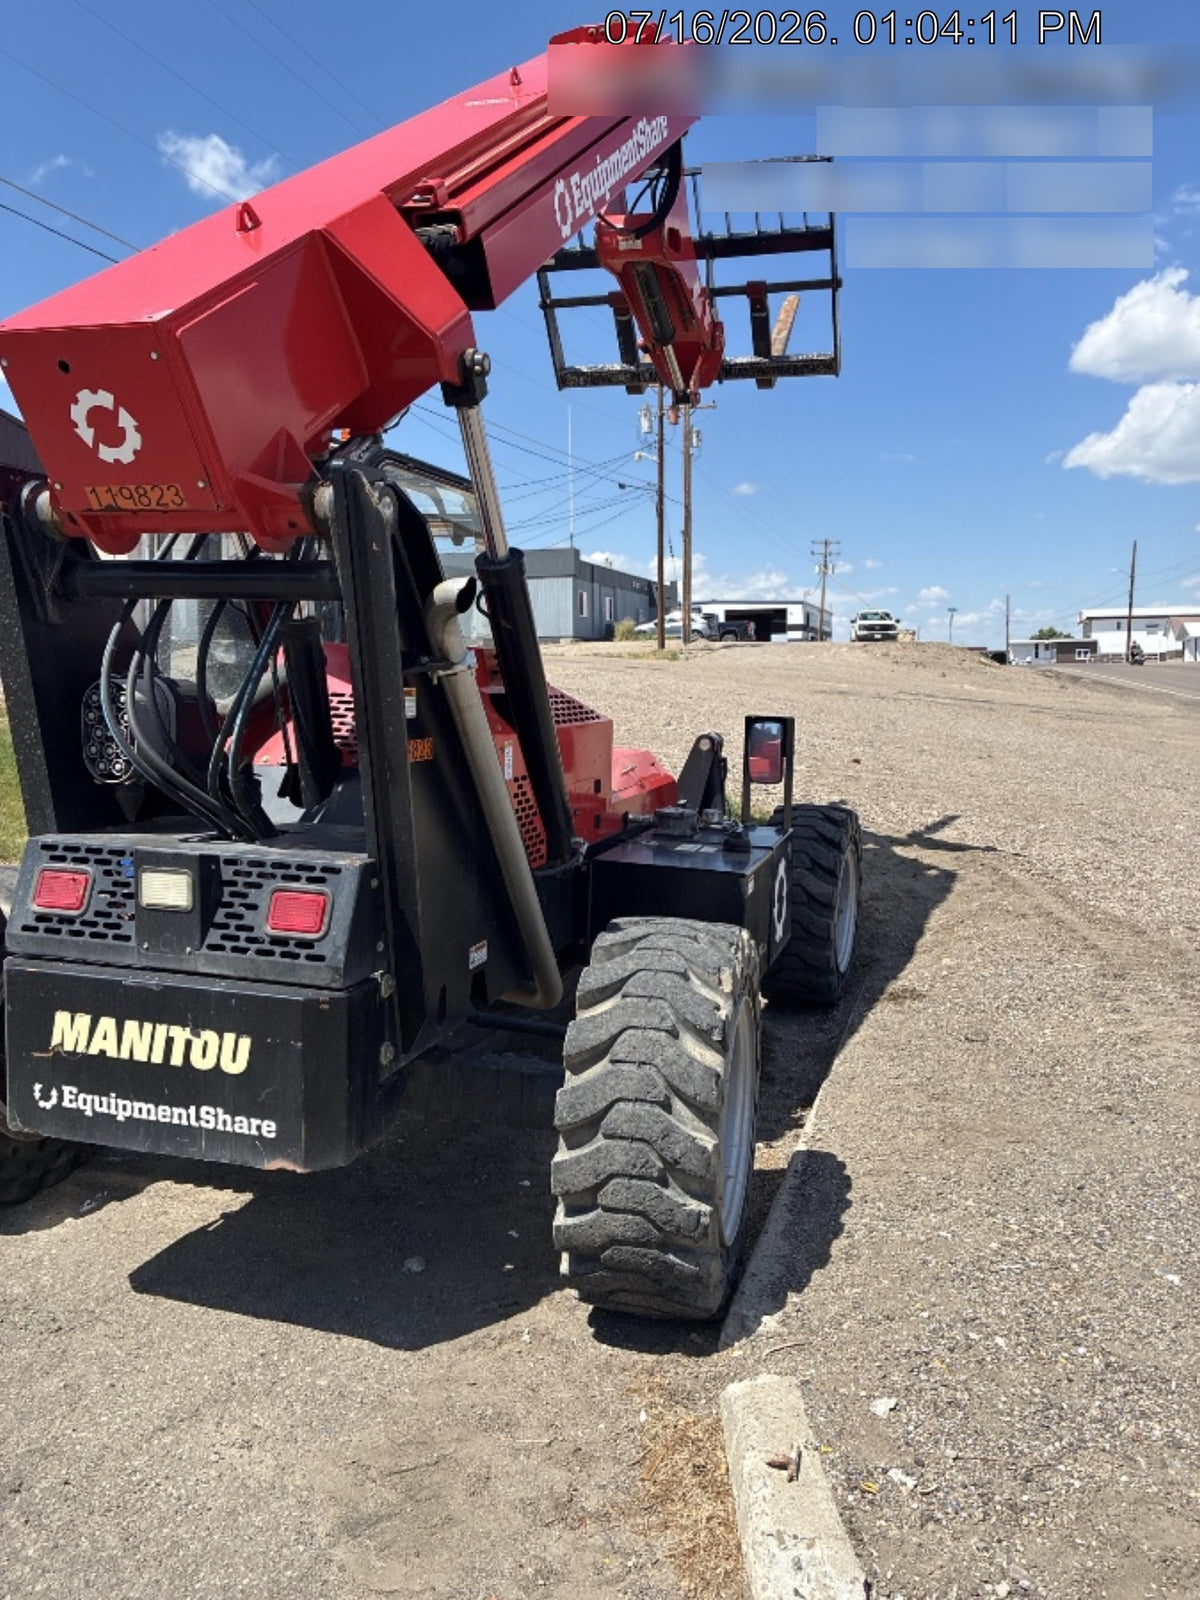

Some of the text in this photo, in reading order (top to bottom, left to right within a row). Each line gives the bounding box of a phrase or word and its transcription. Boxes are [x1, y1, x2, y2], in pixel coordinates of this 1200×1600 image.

[570, 115, 668, 219] EquipmentShare
[89, 485, 185, 508] 119823
[50, 1009, 251, 1075] MANITOU
[61, 1084, 277, 1139] EquipmentShare
